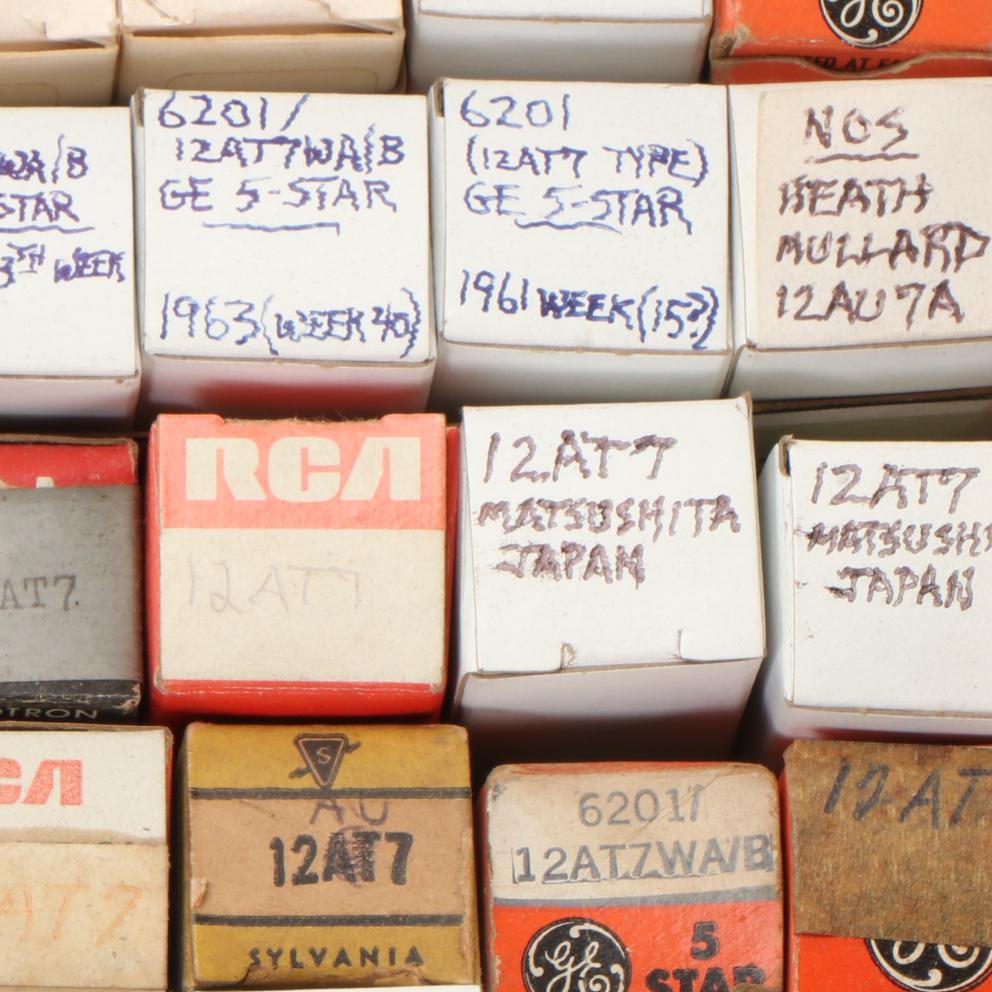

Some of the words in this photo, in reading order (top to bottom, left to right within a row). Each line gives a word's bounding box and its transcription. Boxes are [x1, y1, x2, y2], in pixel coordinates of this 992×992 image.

[158, 92, 312, 131] 6201/
[460, 90, 570, 131] 6201
[804, 105, 909, 151] NOS
[466, 134, 588, 179] (12AT7
[602, 138, 709, 188] TYPE)
[159, 176, 213, 212] GE
[235, 175, 397, 213] 5-STAR
[464, 181, 526, 216] GE
[542, 184, 693, 236] 5-STAR
[778, 172, 934, 217] HEATH
[53, 246, 126, 283] WEEK
[775, 221, 991, 273] MULLARD
[461, 268, 529, 314] 1961
[776, 279, 966, 331] 12AU7A
[185, 436, 422, 503] RCA
[483, 429, 679, 483] 12AT7
[812, 463, 982, 514] 12AT7
[475, 494, 742, 542] MATSUSHITA
[492, 542, 648, 589] JAPAN
[825, 564, 975, 611] JAPAN
[823, 759, 992, 829] 12AT
[269, 830, 414, 888] 12AT7
[248, 946, 425, 970] SYLVANIA
[689, 921, 721, 961] 5
